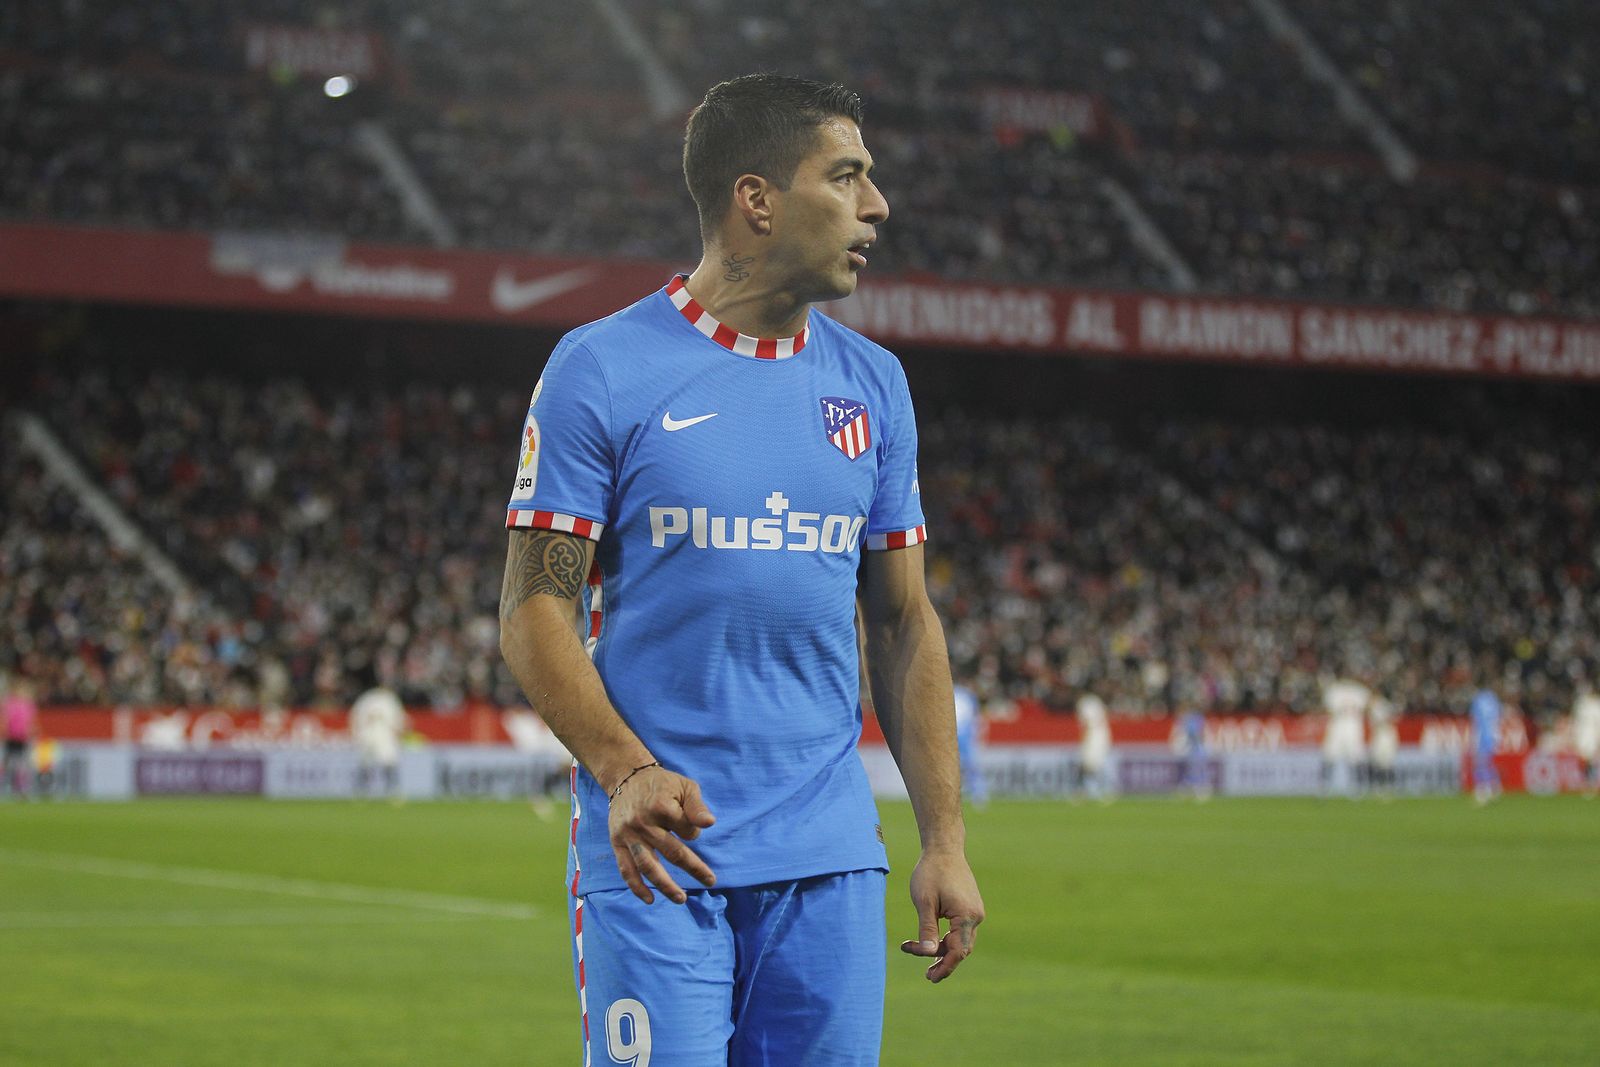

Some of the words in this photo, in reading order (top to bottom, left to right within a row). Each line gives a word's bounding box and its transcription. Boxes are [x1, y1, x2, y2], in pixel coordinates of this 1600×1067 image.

[1063, 297, 1124, 349] AL
[649, 492, 868, 554] Plus500
[605, 998, 652, 1067] 9
